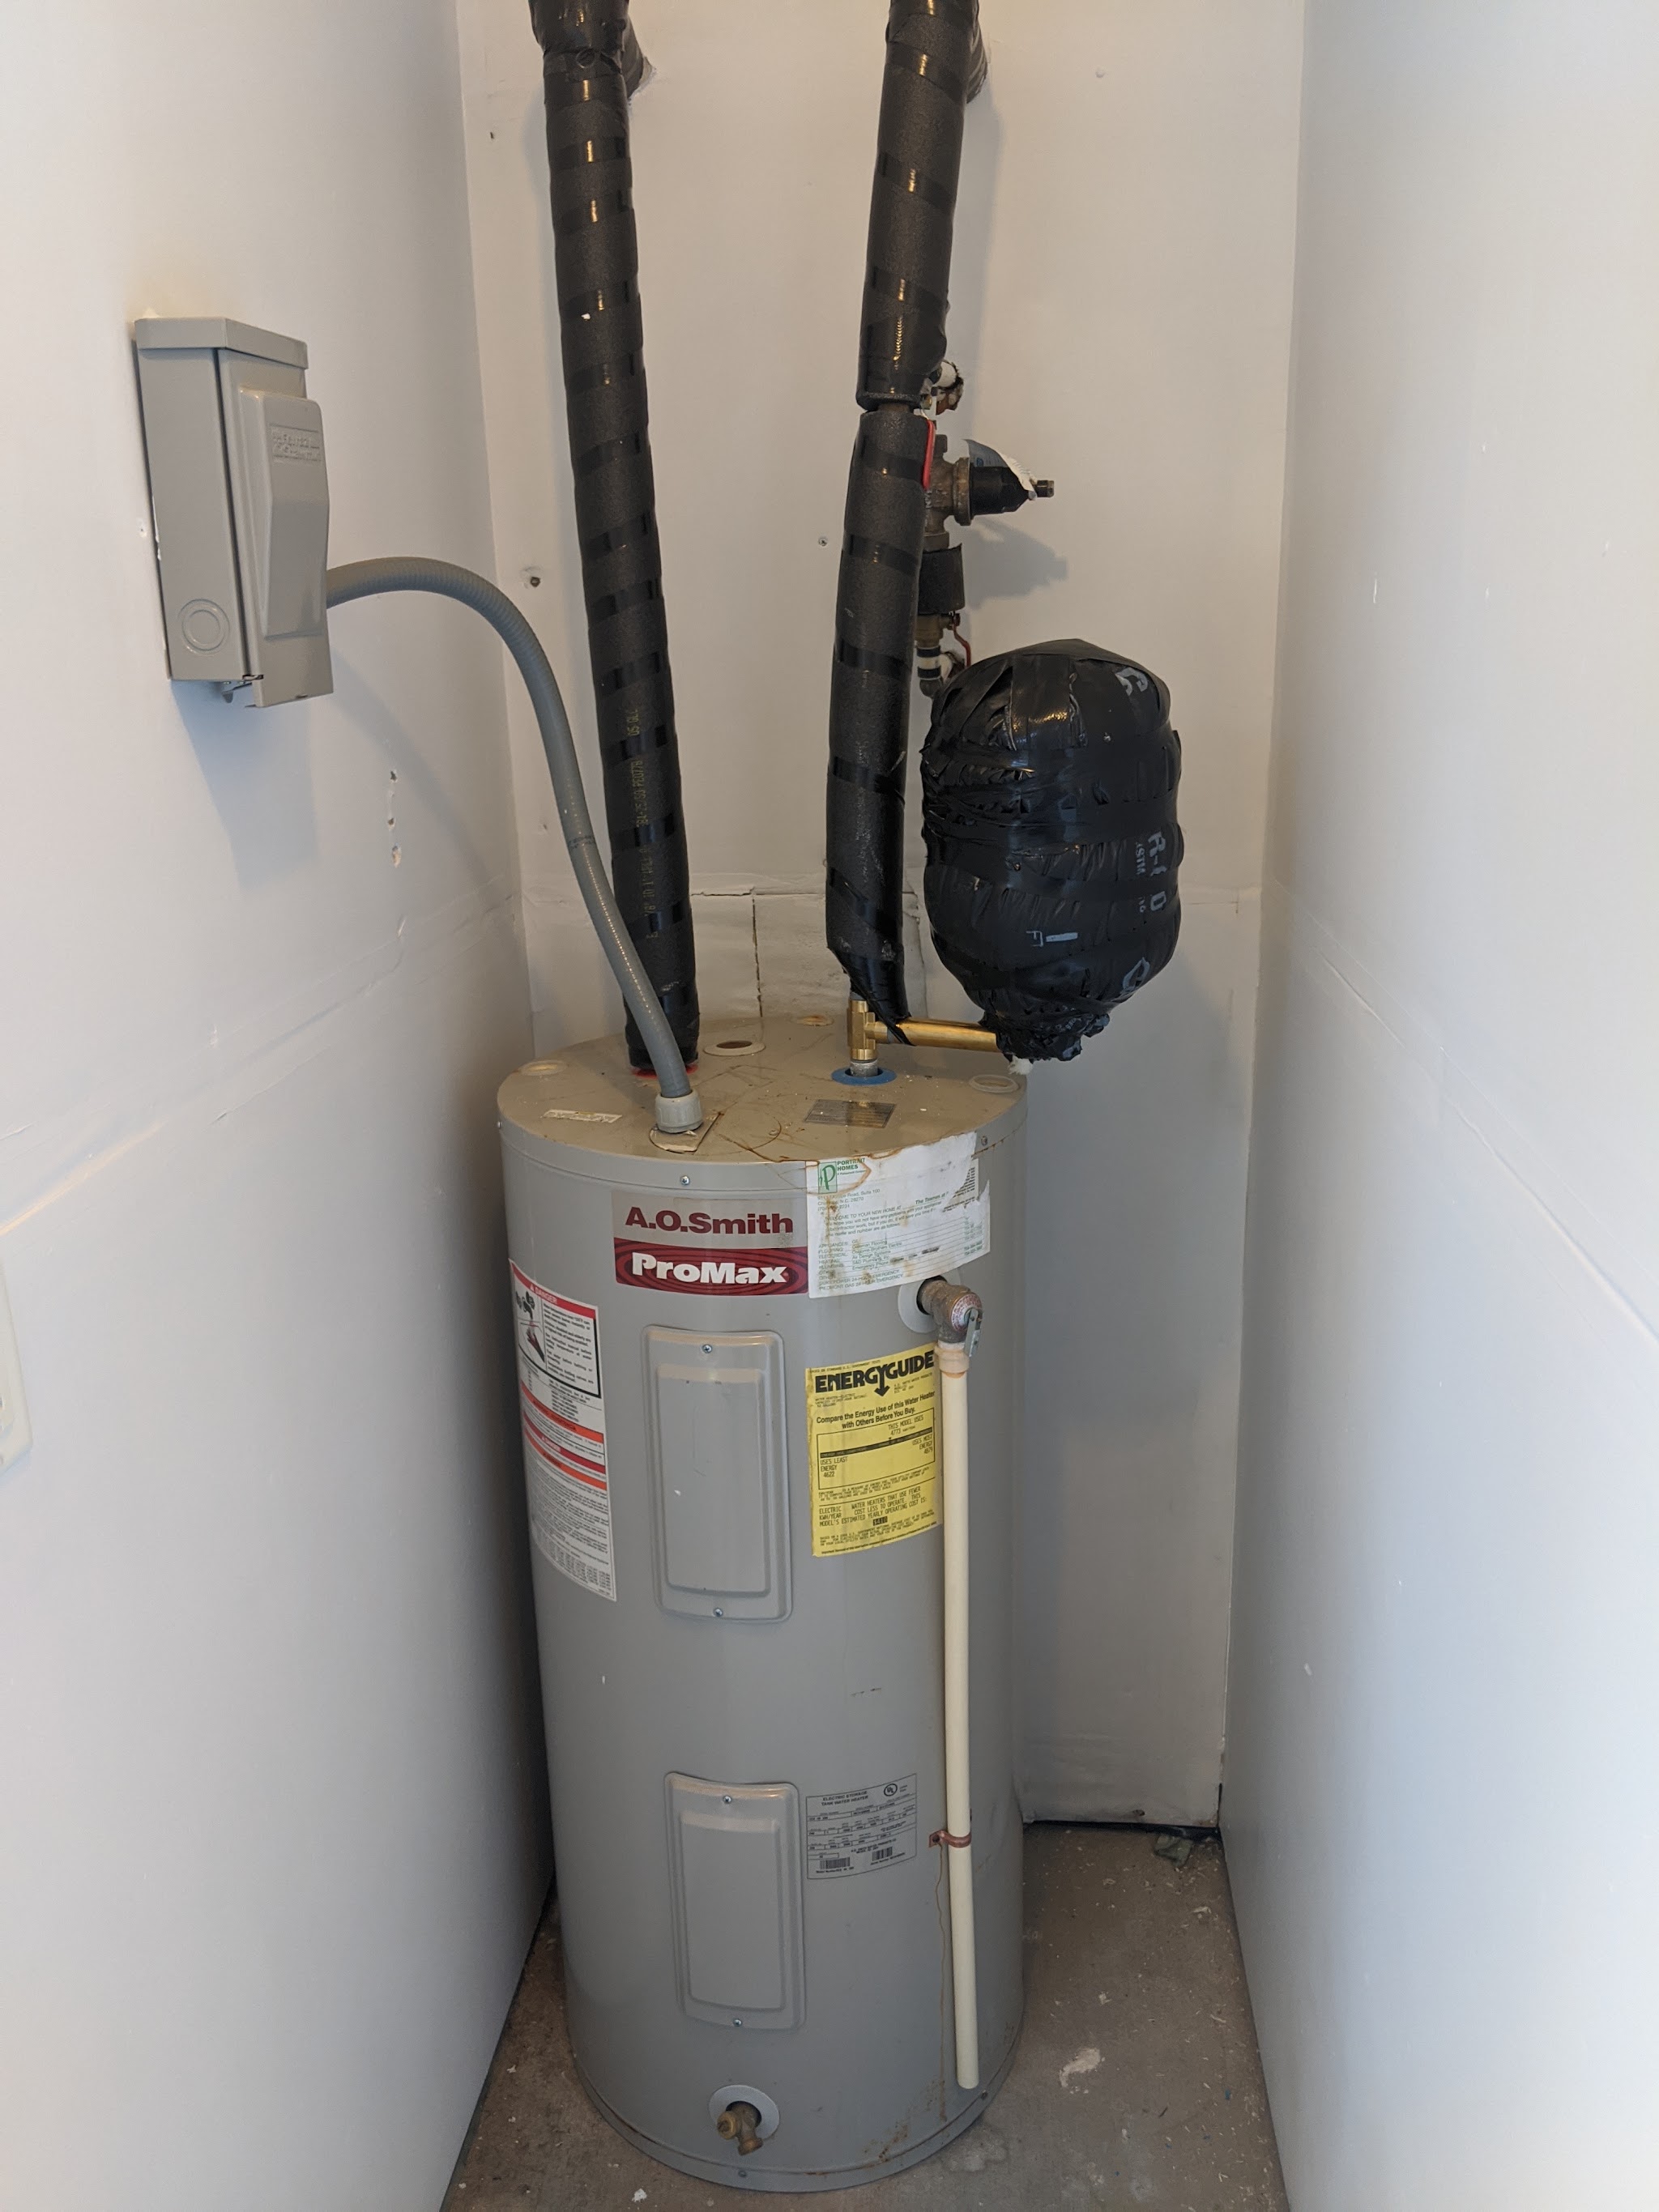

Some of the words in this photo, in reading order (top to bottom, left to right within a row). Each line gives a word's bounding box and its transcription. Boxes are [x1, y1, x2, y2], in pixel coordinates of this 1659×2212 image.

[837, 1157, 866, 1166] PORTRAIT
[625, 1206, 793, 1234] A.O.Smith
[632, 1251, 787, 1284] ProMax
[815, 1350, 934, 1396] ENERGYGUIDE
[817, 1414, 843, 1424] Compare
[855, 1409, 875, 1418] Energy
[876, 1405, 887, 1413] Use
[904, 1397, 919, 1405] Water
[919, 1391, 935, 1401] Heater
[855, 1417, 874, 1426] Others
[875, 1413, 893, 1423] Before
[904, 1407, 915, 1415] Buy.
[888, 1422, 898, 1430] THIS
[914, 1414, 924, 1423] USES
[821, 1464, 837, 1473] ENERGY
[834, 1456, 848, 1464] LEAST
[819, 1507, 842, 1515] ELECTRIC
[851, 1501, 865, 1510] WATER
[867, 1497, 885, 1507] HEATERS
[887, 1494, 898, 1502] THAT
[899, 1490, 907, 1498] USE
[908, 1485, 921, 1495] FEWER
[819, 1512, 842, 1521] KWH/YEAR
[854, 1507, 865, 1515] COST
[911, 1492, 921, 1500] THIS
[819, 1519, 839, 1527] MODEL'S
[841, 1515, 865, 1524] ESTIMATED
[868, 1510, 883, 1519] YEARLY
[885, 1502, 907, 1515] OPERATING
[908, 1498, 919, 1507] COST
[846, 1790, 868, 1799] STORAGE
[851, 1795, 868, 1803] HEATER
